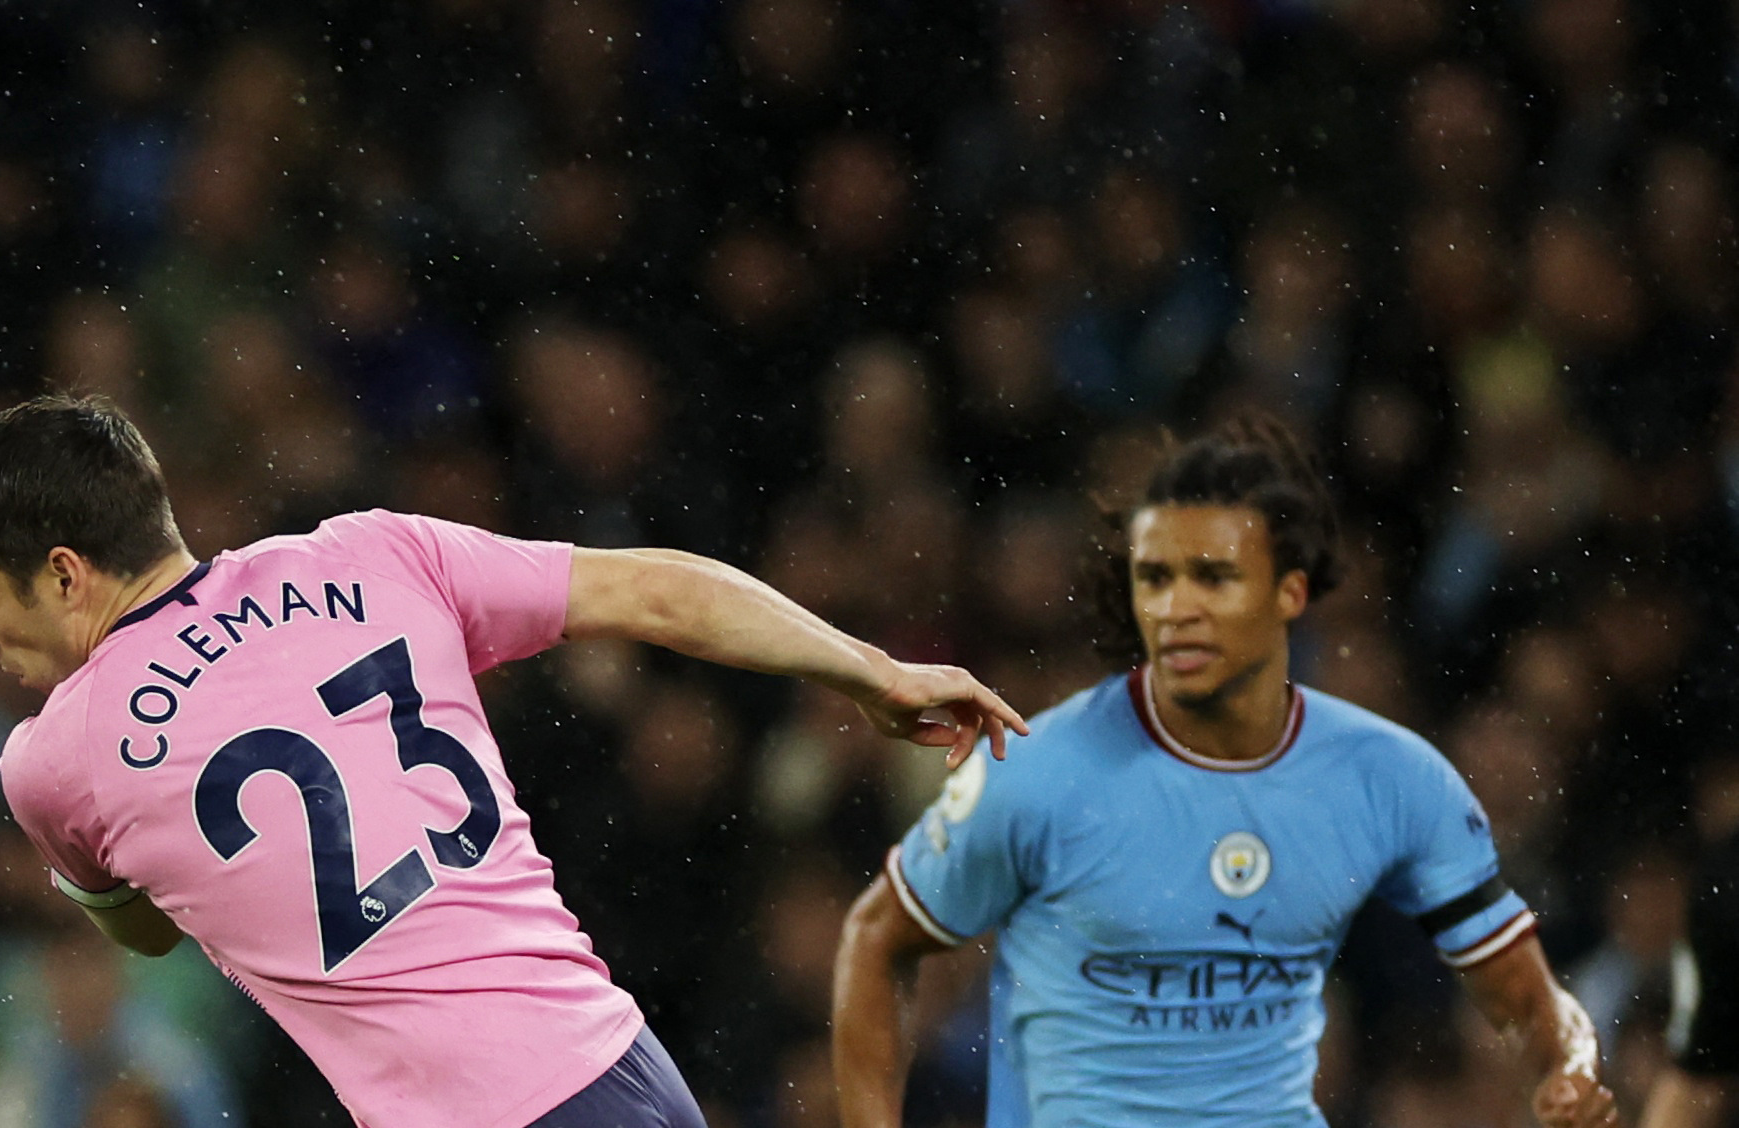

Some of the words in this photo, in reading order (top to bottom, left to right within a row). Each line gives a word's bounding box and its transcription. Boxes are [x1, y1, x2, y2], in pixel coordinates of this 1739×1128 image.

[119, 581, 367, 771] COLEMAN
[192, 634, 504, 976] 23
[1080, 953, 1312, 998] ETIHA
